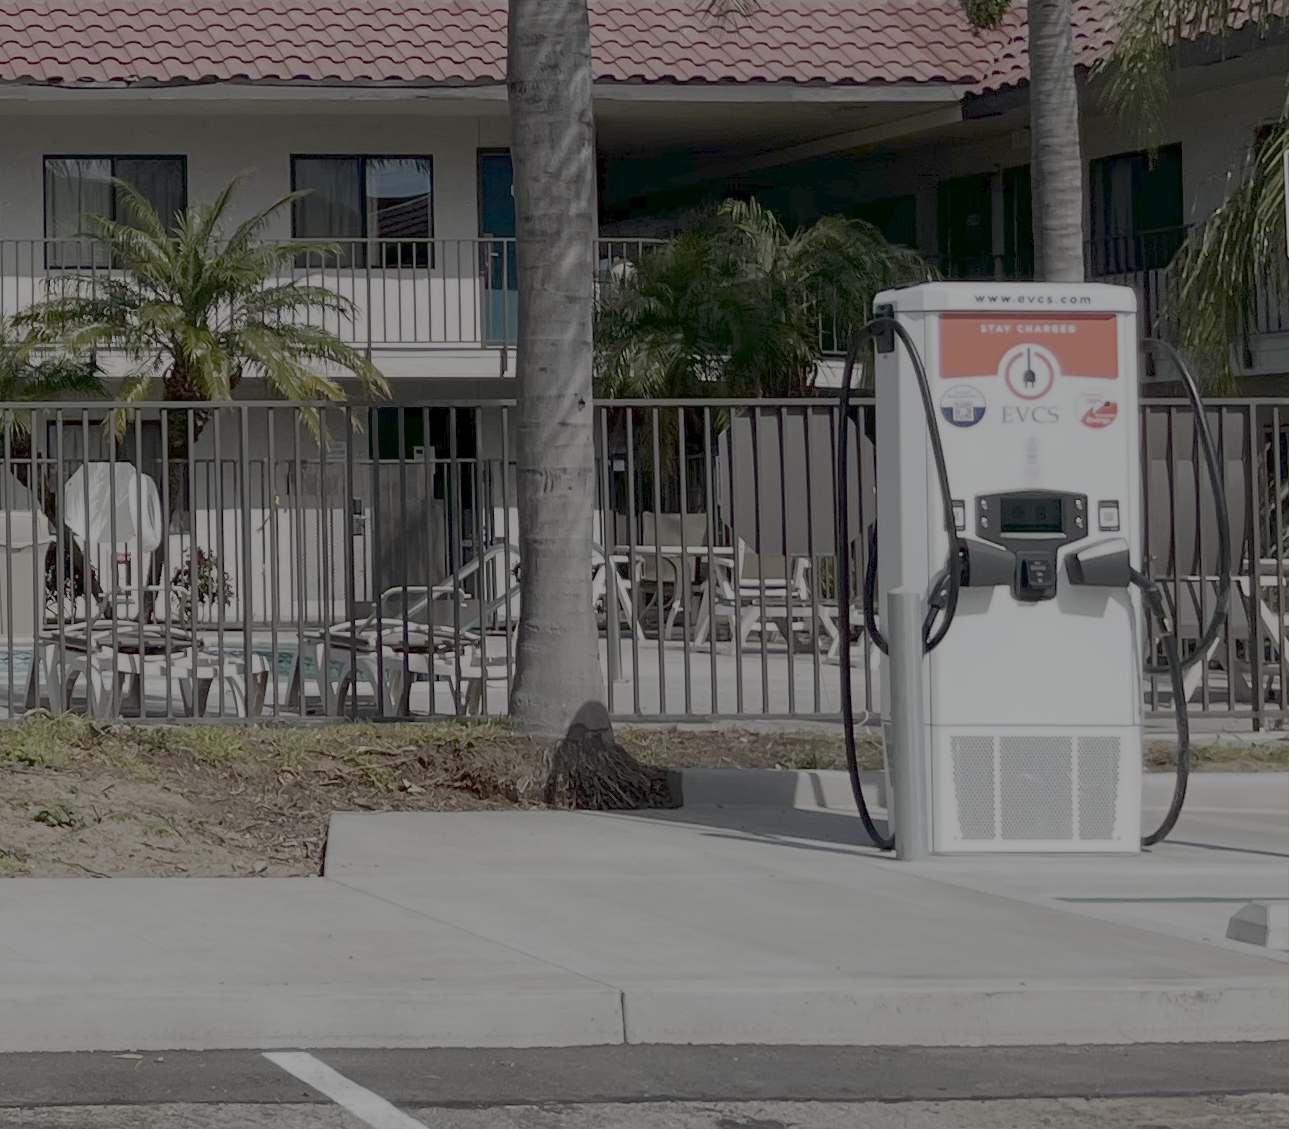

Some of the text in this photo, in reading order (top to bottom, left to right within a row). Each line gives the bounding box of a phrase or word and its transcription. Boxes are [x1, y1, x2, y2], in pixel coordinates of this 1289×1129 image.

[974, 295, 1092, 304] www.evcs.com
[980, 324, 1077, 334] STAY CHARGED
[1001, 406, 1060, 424] EVCS
